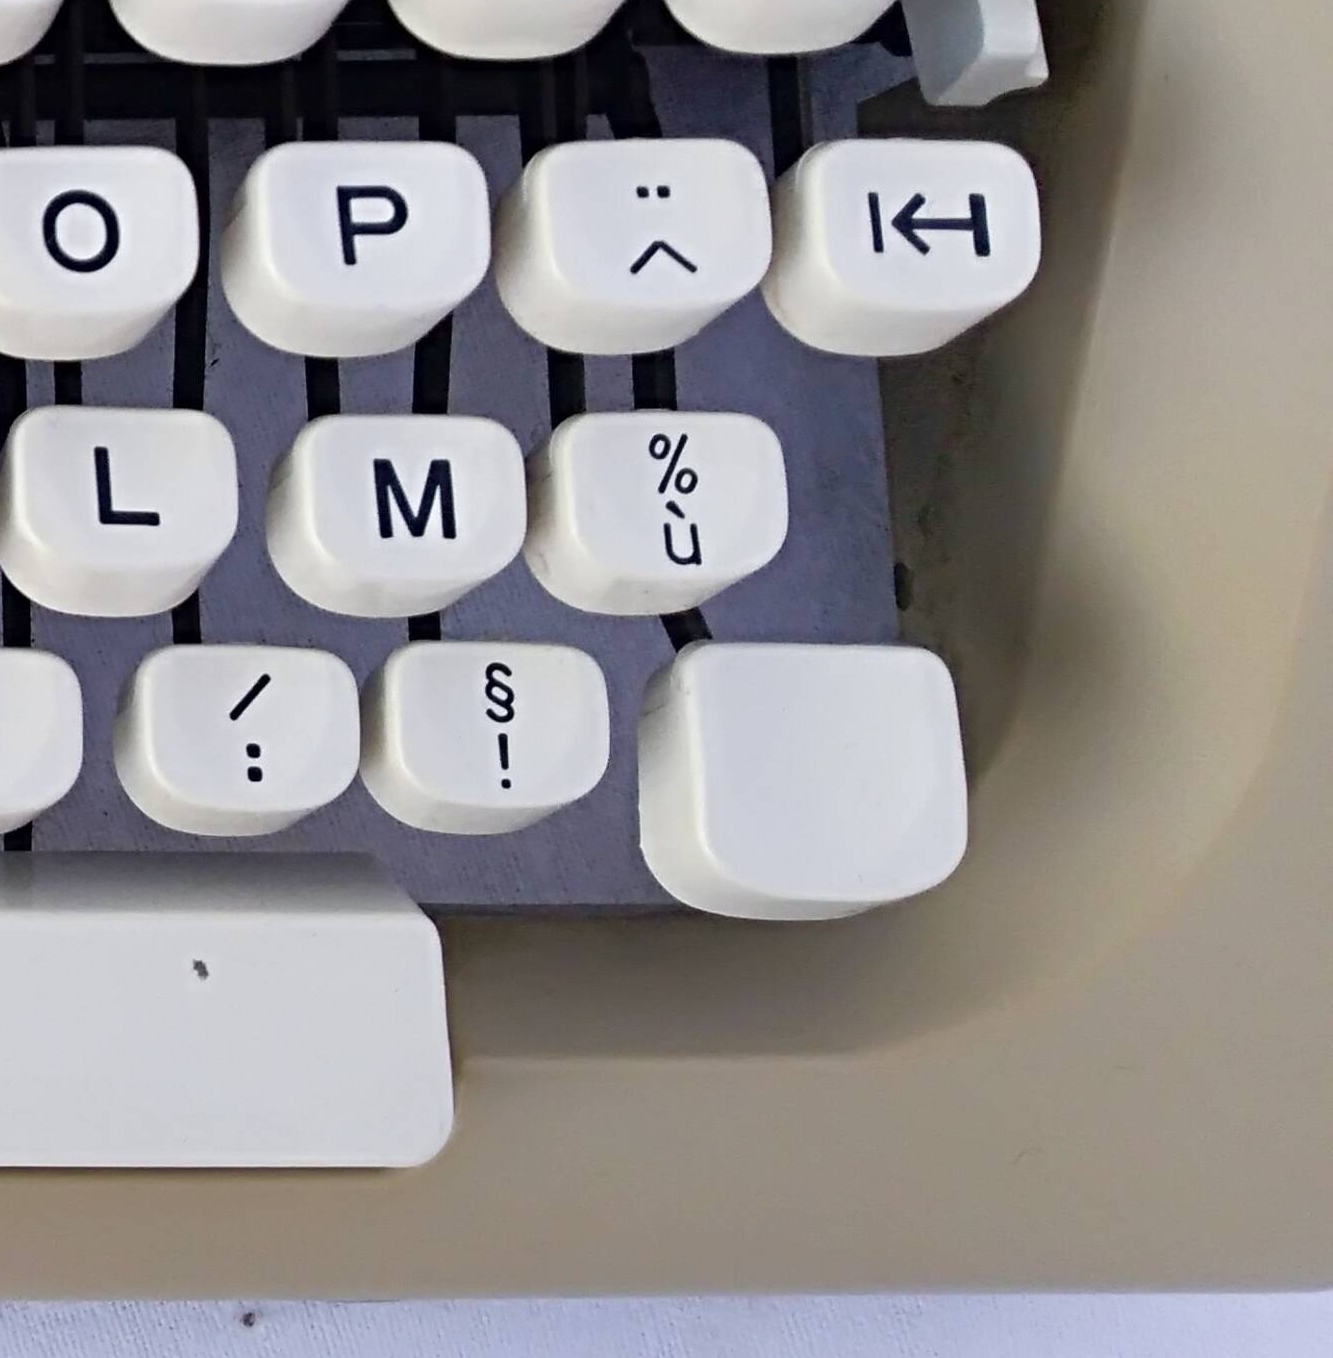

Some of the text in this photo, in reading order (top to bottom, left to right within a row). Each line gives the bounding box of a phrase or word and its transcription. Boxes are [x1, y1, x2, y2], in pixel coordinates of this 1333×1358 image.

[43, 190, 119, 273] O
[336, 186, 408, 265] P
[94, 447, 160, 526] L
[649, 434, 698, 494] %
[373, 459, 456, 539] M
[664, 501, 702, 565] ù
[229, 674, 271, 721] /
[485, 663, 514, 723] §
[246, 743, 262, 782] :
[498, 733, 511, 789] !
